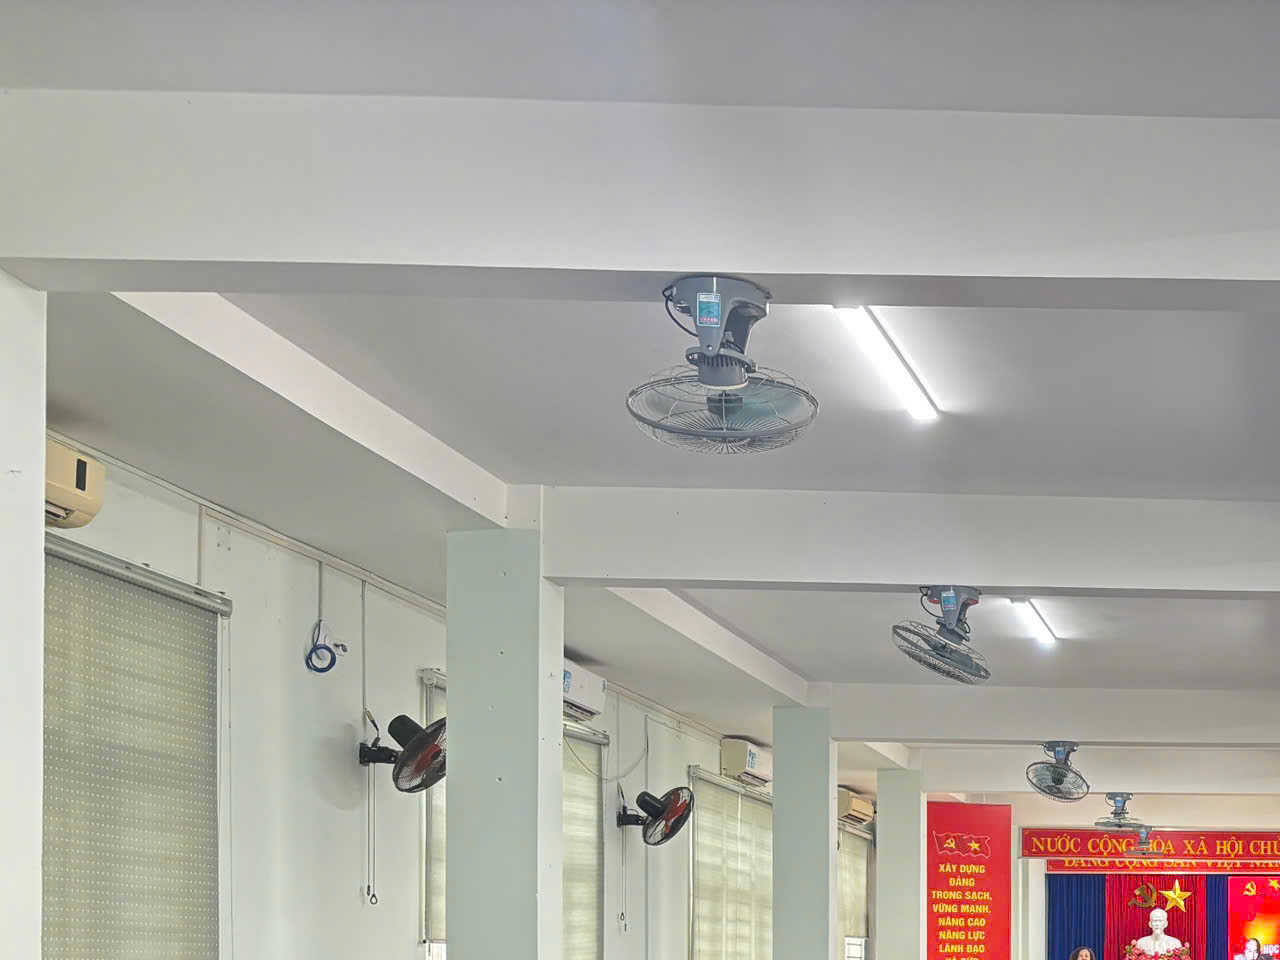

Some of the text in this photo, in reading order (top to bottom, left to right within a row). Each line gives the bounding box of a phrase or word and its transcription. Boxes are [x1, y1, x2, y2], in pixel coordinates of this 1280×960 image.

[1031, 833, 1081, 852] NƯỚC
[1088, 834, 1134, 856] CỘNG
[1216, 836, 1243, 858] HỘI
[931, 890, 962, 899] TRONG
[968, 918, 986, 927] CAO
